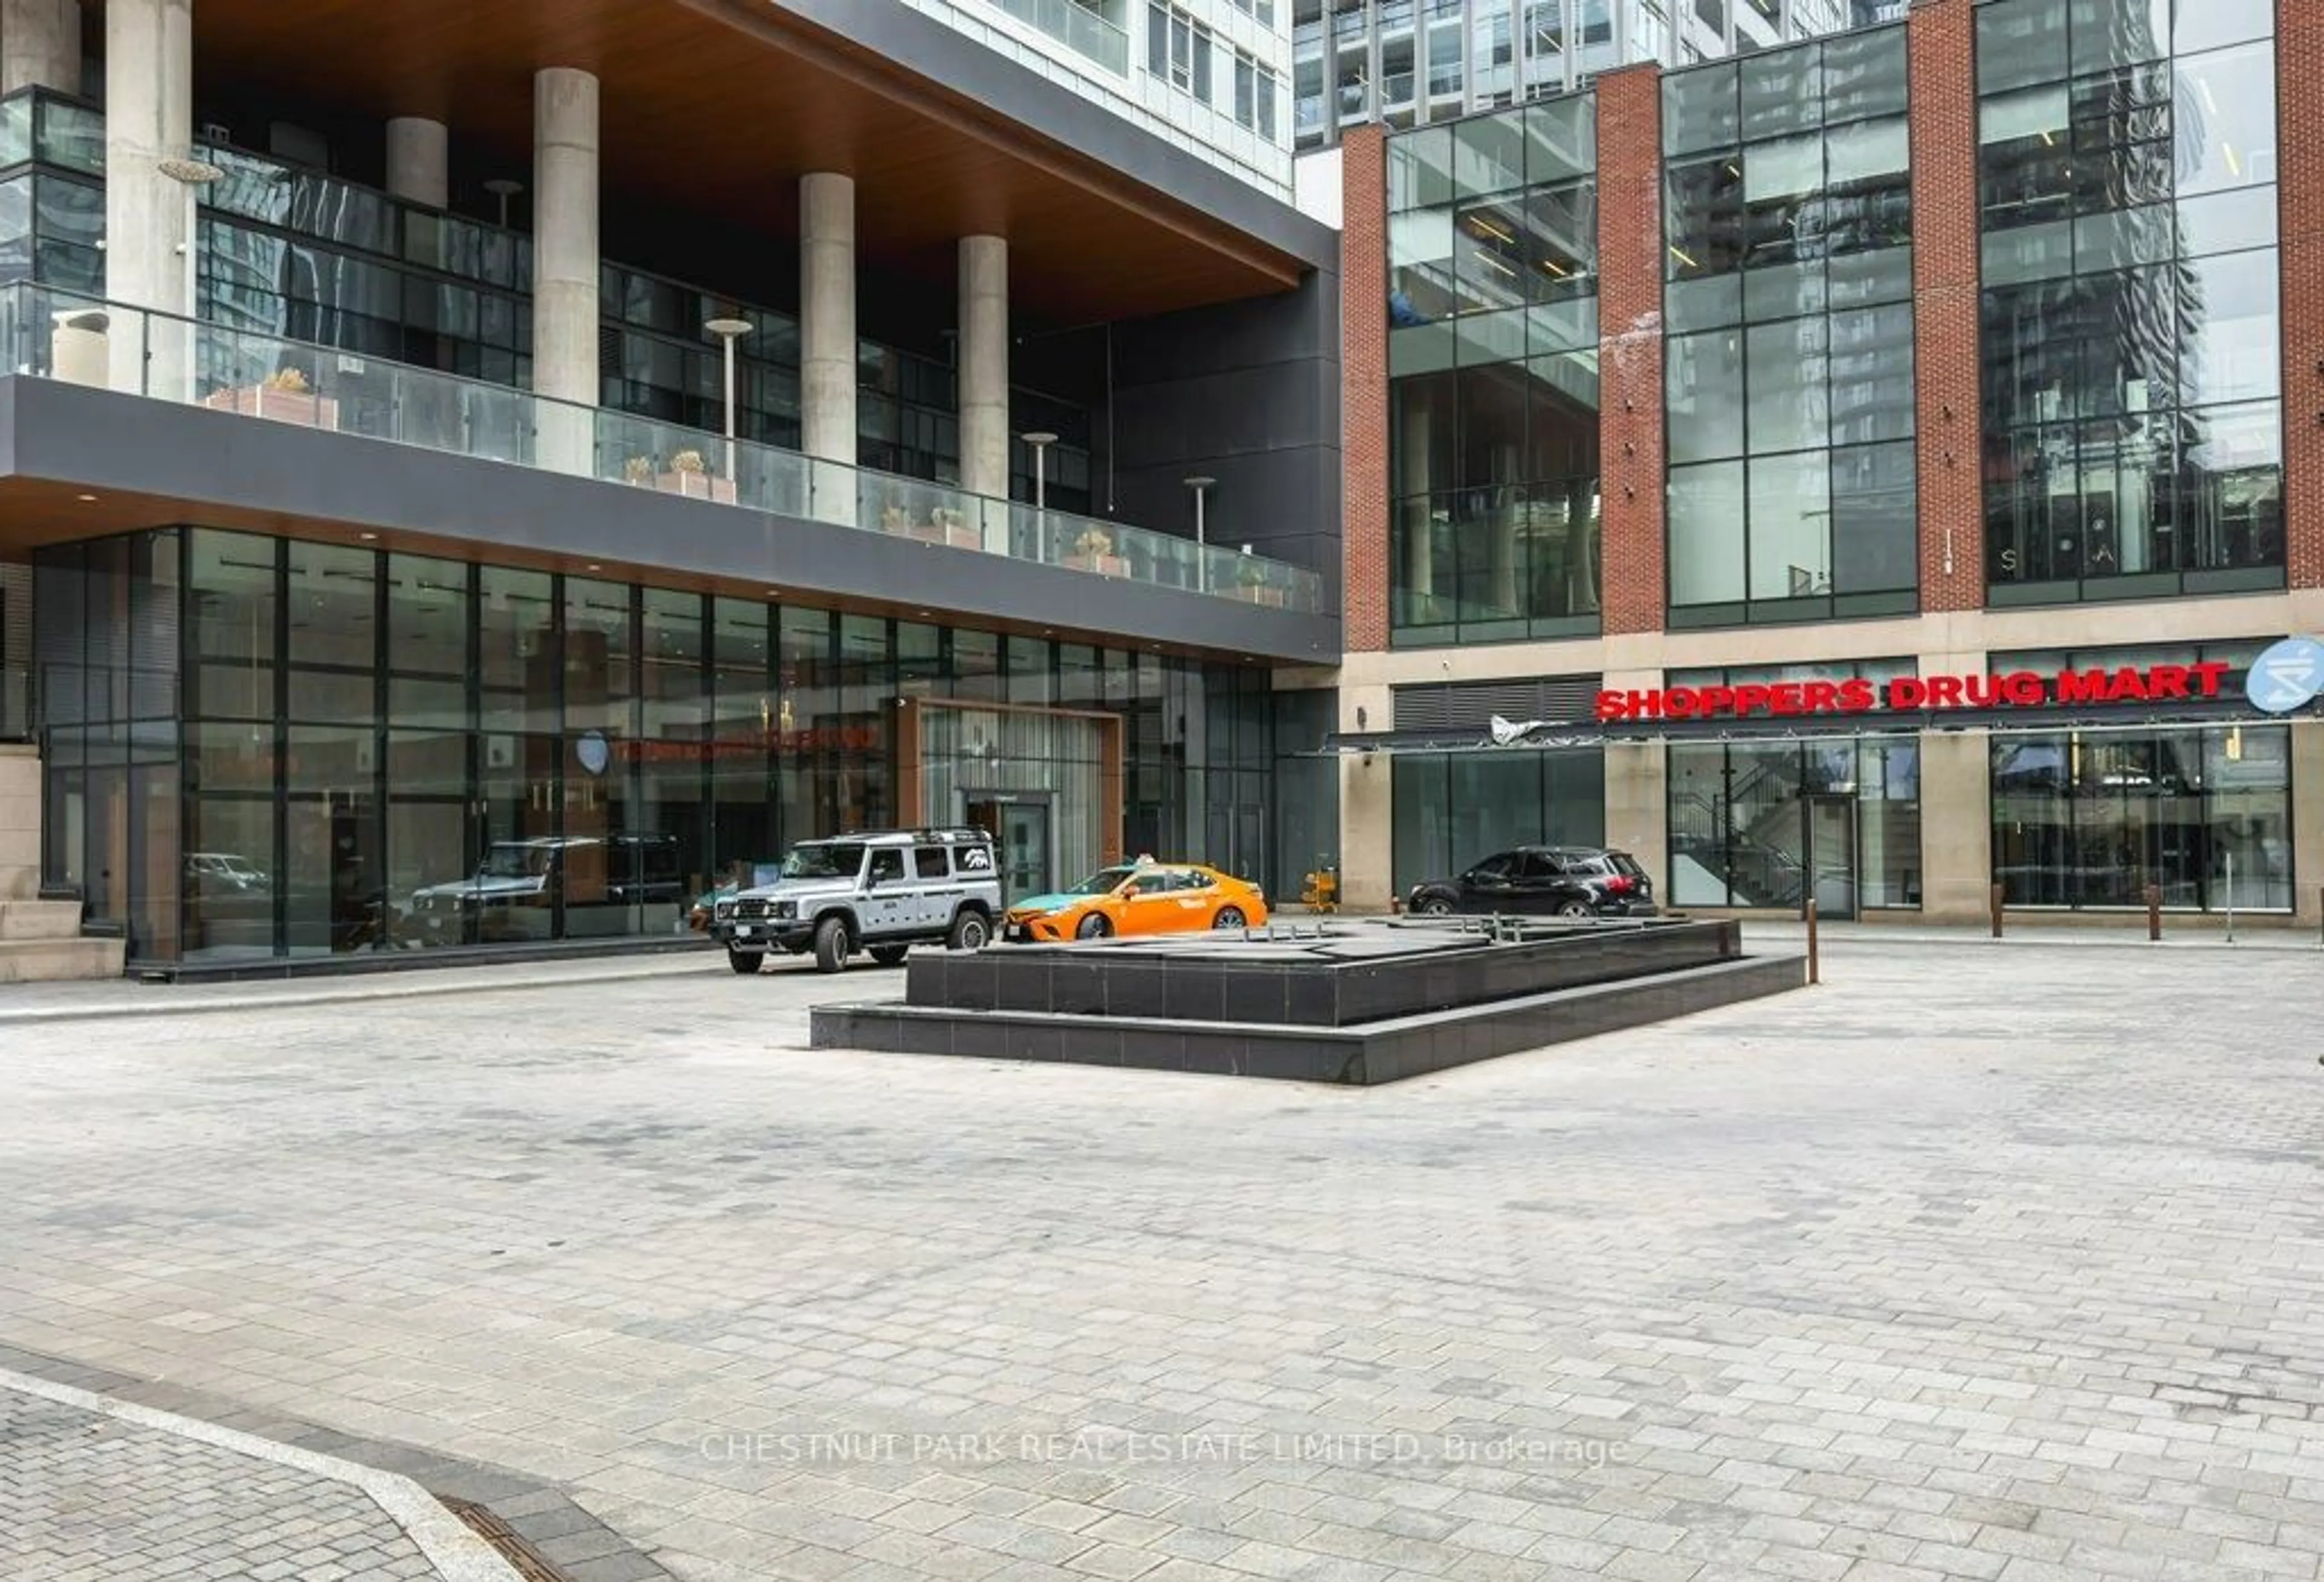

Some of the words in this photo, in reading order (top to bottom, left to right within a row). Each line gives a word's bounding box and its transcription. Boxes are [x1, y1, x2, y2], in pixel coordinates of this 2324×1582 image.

[1595, 678, 1874, 720] SHOPPERS
[1889, 671, 2046, 708] DRUG
[2057, 661, 2229, 702] MART
